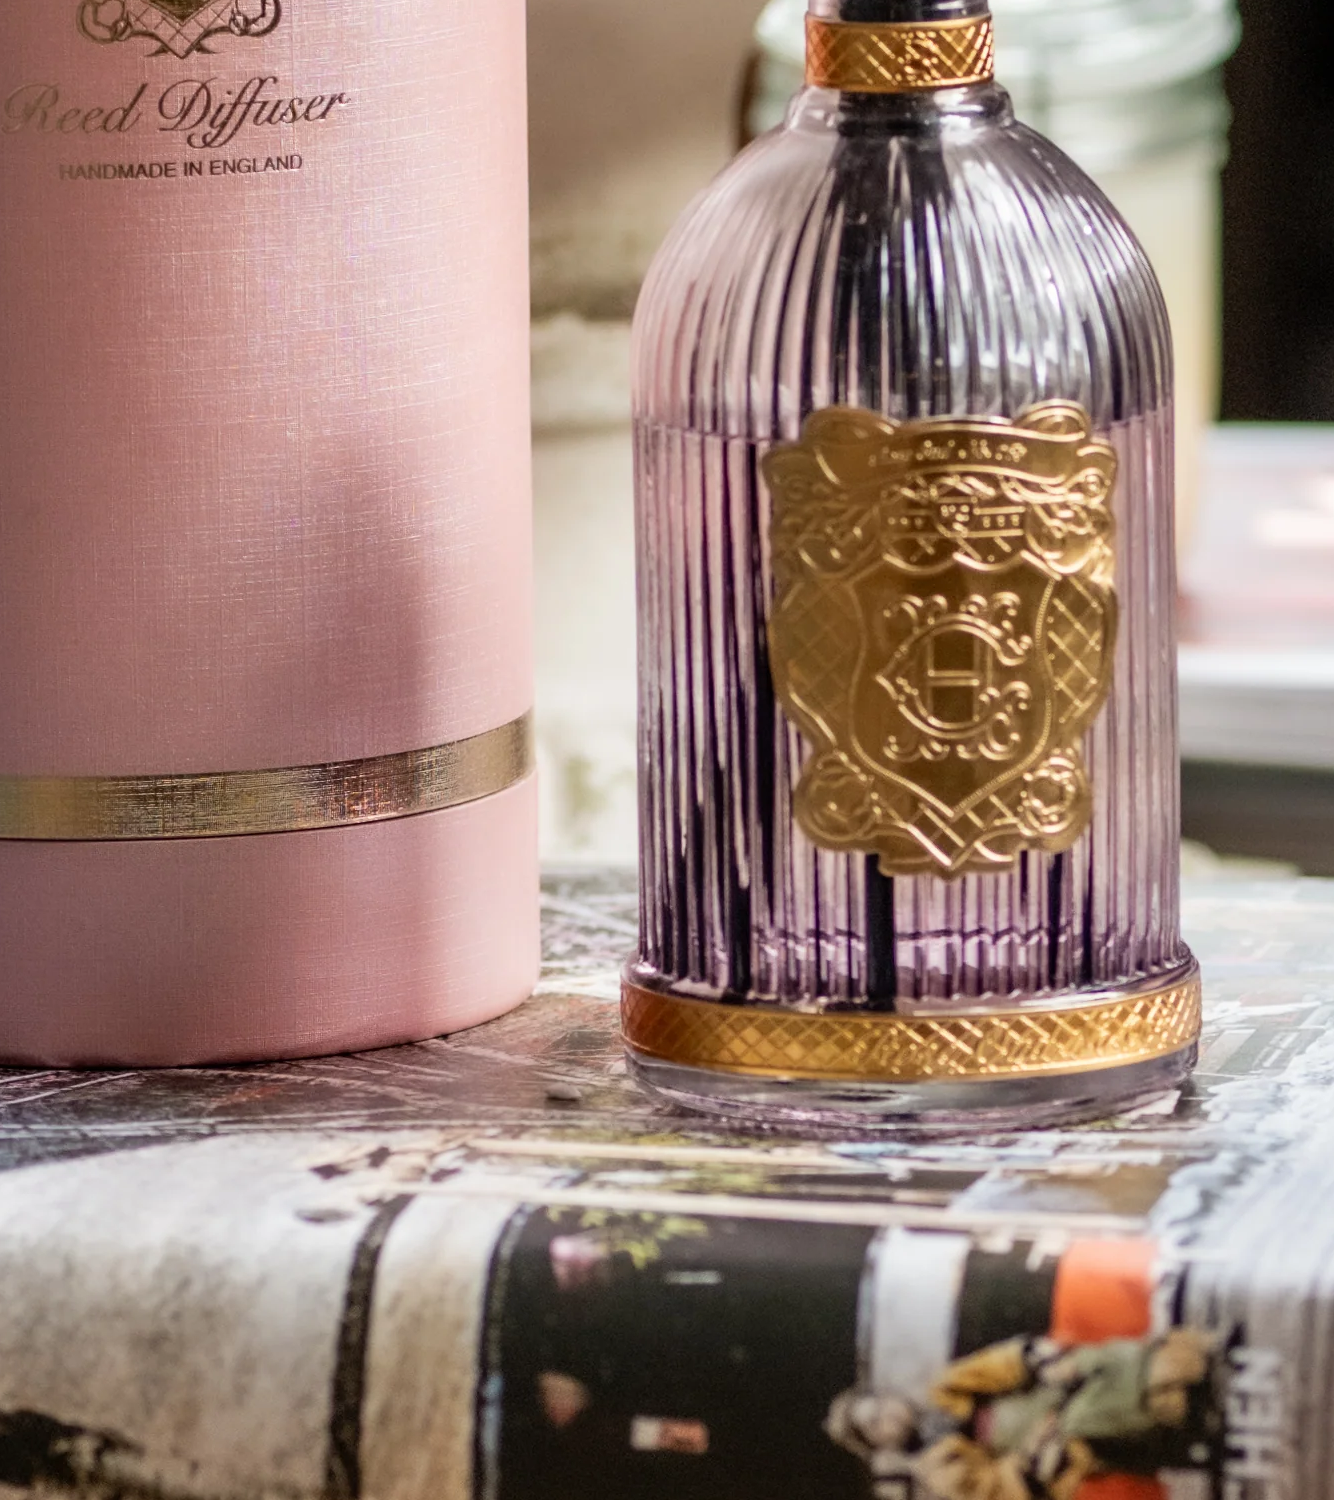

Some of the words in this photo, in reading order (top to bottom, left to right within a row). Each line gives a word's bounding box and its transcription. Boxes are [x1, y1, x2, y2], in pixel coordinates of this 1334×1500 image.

[0, 82, 150, 136] Reed
[158, 76, 353, 150] Diffuser
[58, 161, 177, 181] HANDMADE
[183, 161, 204, 178] IN
[209, 153, 304, 177] ENGLAND
